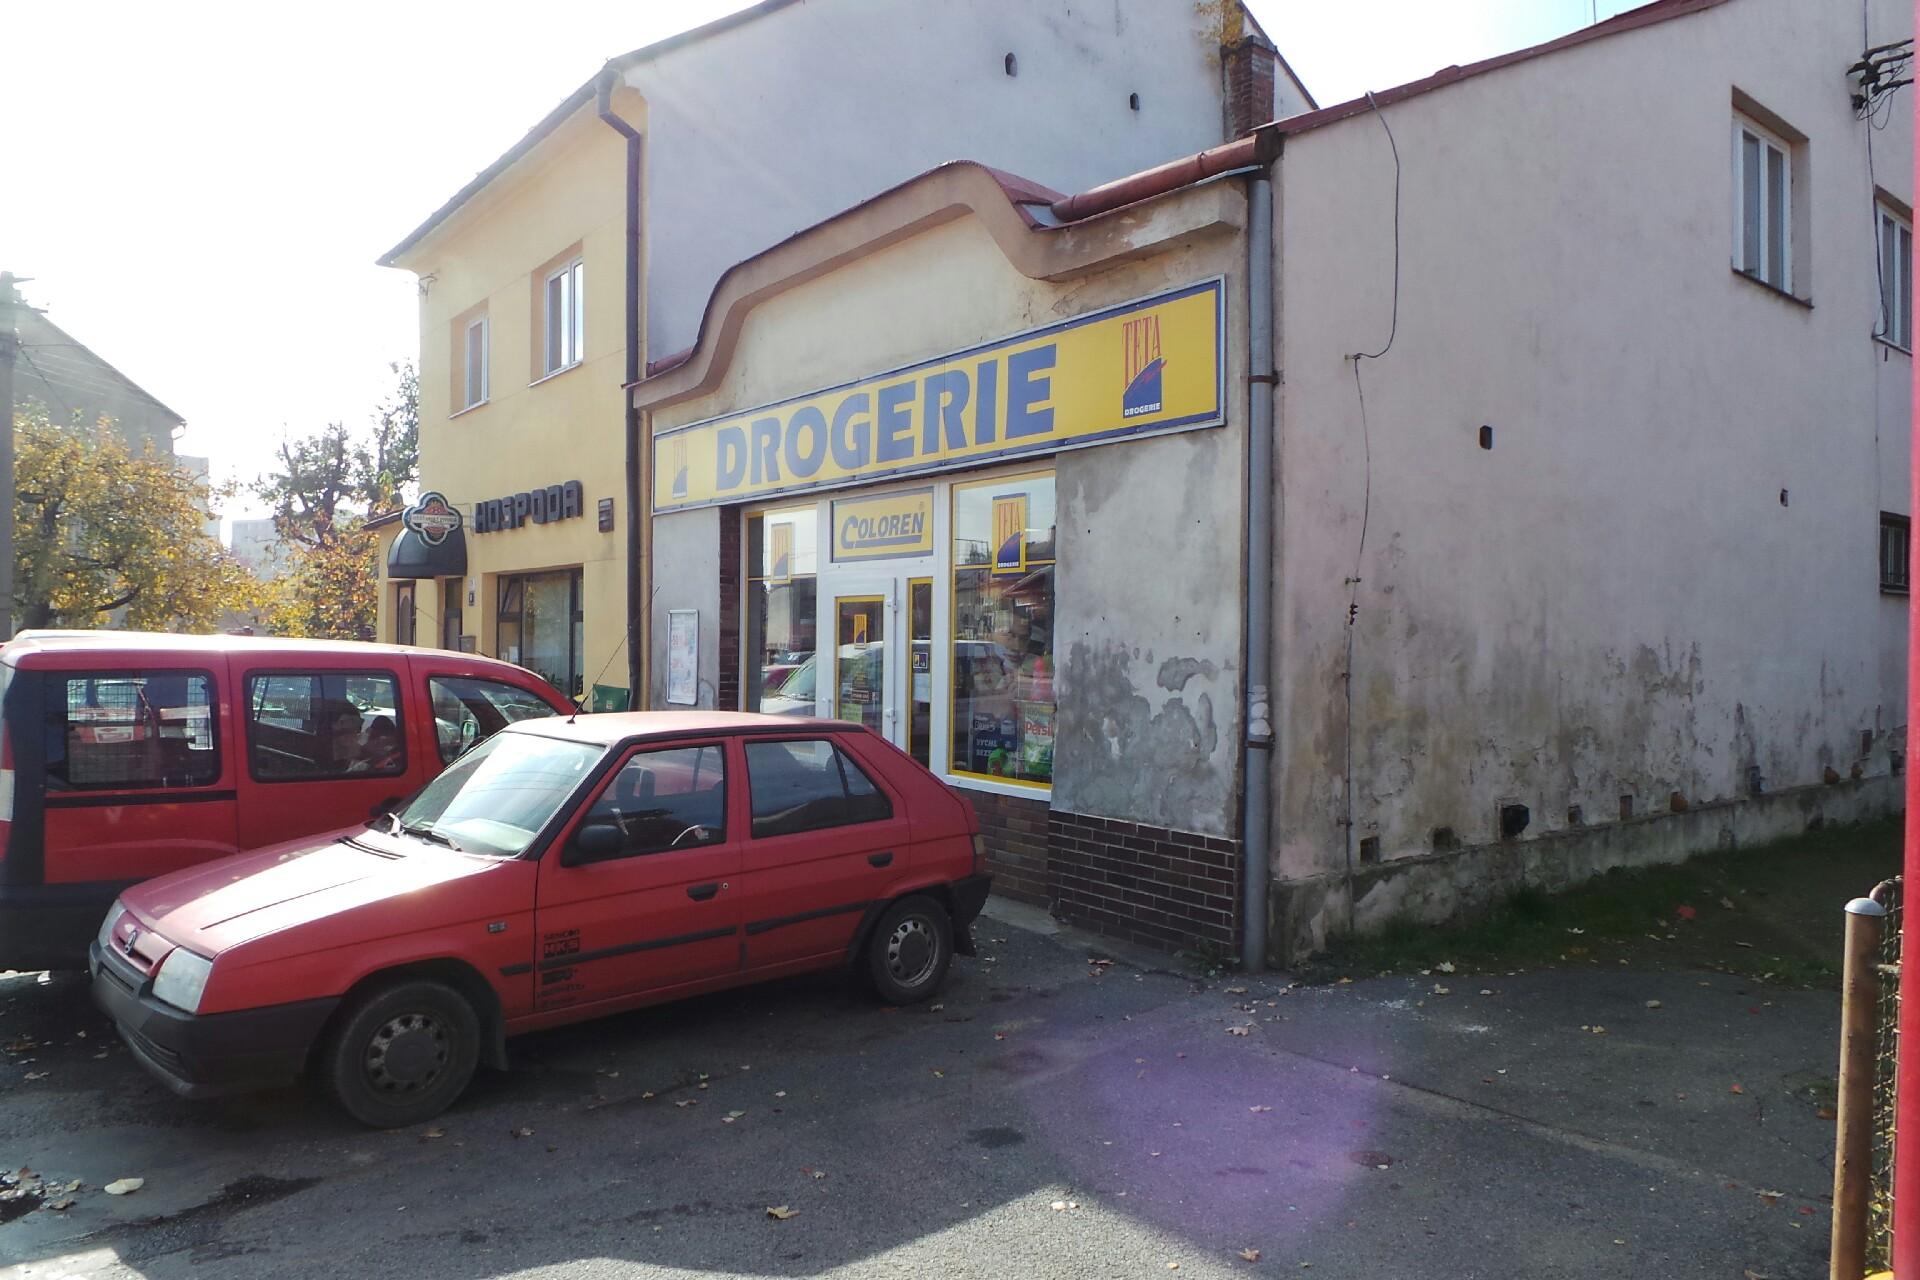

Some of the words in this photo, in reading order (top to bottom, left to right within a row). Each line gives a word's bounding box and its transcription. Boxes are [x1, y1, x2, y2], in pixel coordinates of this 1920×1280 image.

[1122, 315, 1162, 391] TETA
[716, 343, 1057, 491] DROGERIE
[1124, 402, 1161, 417] DROGERIE
[475, 480, 584, 534] HOSPODA
[840, 511, 925, 550] COLOREN
